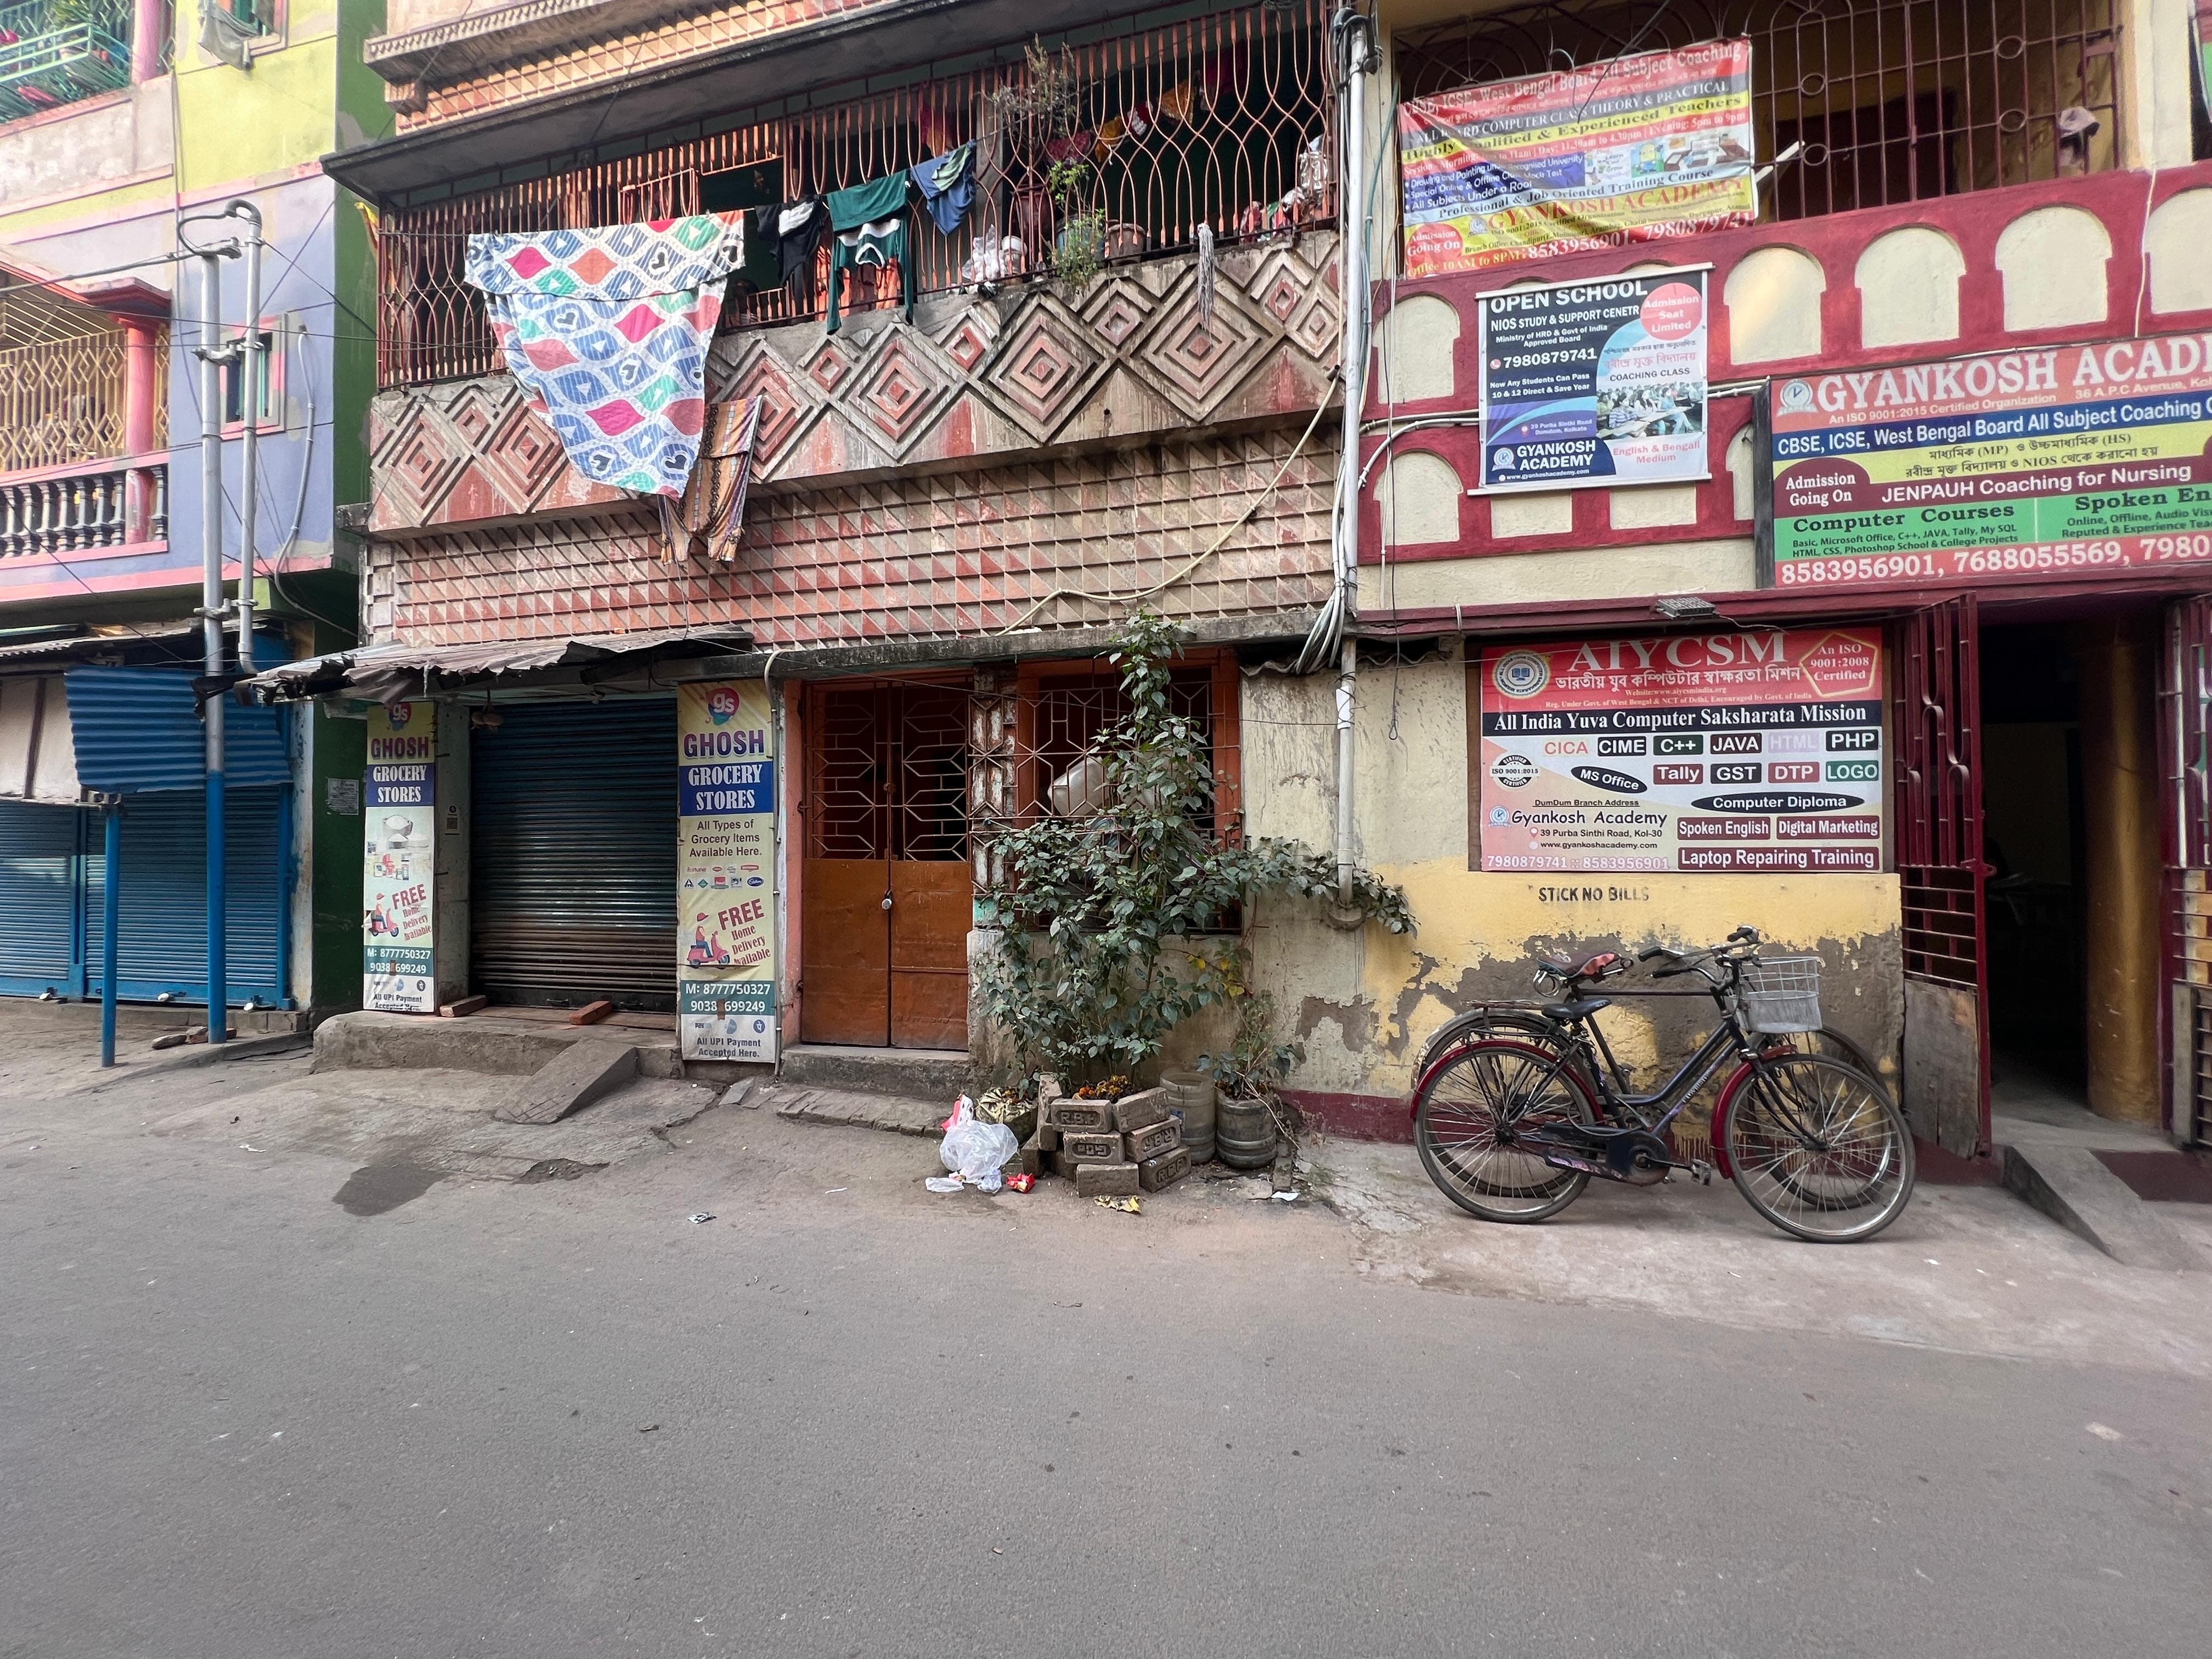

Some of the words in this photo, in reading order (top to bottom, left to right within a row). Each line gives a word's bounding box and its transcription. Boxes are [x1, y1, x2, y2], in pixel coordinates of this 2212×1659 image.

[1515, 73, 1555, 99] Bengal
[1677, 42, 1742, 66] Coaching
[1482, 110, 1547, 134] COMPUTER
[1593, 98, 1640, 115] THEORY
[1657, 81, 1729, 103] PRACTICAL
[1558, 110, 1660, 135] Experienced
[1669, 97, 1741, 114] Teachers
[1440, 199, 1509, 218] Professional
[1609, 177, 1664, 193] Training
[1668, 168, 1713, 182] Course
[1412, 230, 1456, 242] Admission
[1407, 242, 1441, 257] Going
[1443, 240, 1460, 250] On
[1443, 257, 1475, 270] 10AM
[1491, 292, 1549, 313] OPEN
[1555, 280, 1647, 306] SCHOOL
[1644, 296, 1699, 308] Admission
[1491, 318, 1517, 332] NIOS
[1519, 316, 1547, 329] STUDY
[1549, 315, 1556, 325] &
[1559, 309, 1601, 324] SUPPORT
[1604, 306, 1639, 318] CENETR
[1658, 309, 1684, 319] Seat
[1496, 335, 1525, 343] Ministry
[1562, 327, 1578, 335] Govt
[1652, 321, 1691, 332] Limited
[1503, 347, 1597, 369] 7980879741
[1610, 371, 1657, 382] COACHING
[1661, 368, 1690, 376] CLASS
[1817, 351, 2057, 413] GYANKOSH
[1829, 415, 1843, 424] An
[1846, 413, 1866, 422] ISO
[1929, 402, 1979, 414] Certified
[1778, 436, 1825, 455] CBSE,
[1829, 431, 1870, 449] ICSE,
[1874, 426, 1912, 446] West
[1916, 421, 1971, 443] Bengal
[1976, 415, 2023, 436] Board
[2028, 412, 2049, 431] All
[2053, 407, 2117, 430] Subject
[2120, 400, 2201, 422] Coaching
[1517, 440, 1596, 458] GYANKOSH
[1613, 446, 1648, 456] English
[1929, 446, 1974, 460] মাধ্যমিক
[2102, 433, 2132, 447] (HS)
[1520, 454, 1593, 471] ACADEMY
[1637, 455, 1676, 464] Medium
[2023, 457, 2057, 468] NIOS
[1785, 472, 1856, 490] Admission
[1882, 480, 1973, 503] JENPAUH
[1979, 475, 2072, 495] Coaching
[2077, 471, 2106, 487] for
[2111, 465, 2192, 484] Nursing
[1790, 490, 1829, 507] Going
[1832, 489, 1852, 503] On
[2075, 493, 2168, 514] Spoken
[1793, 513, 1905, 533] Computer
[1921, 505, 2015, 523] Courses
[2155, 510, 2189, 520] Audio
[1820, 535, 1864, 546] Microsoft
[1866, 533, 1895, 542] Office,
[1980, 526, 1995, 535] My
[1998, 524, 2017, 533] SQL
[2062, 527, 2109, 538] Reputed
[2124, 522, 2186, 535] Experience
[1844, 542, 1895, 554] Photoshop
[1898, 540, 1928, 550] School
[1940, 537, 1976, 548] College
[1979, 534, 2018, 546] Projects
[1781, 555, 1944, 584] 8583956901,
[1953, 540, 2130, 572] 7688055569,
[1566, 631, 1788, 672] AIYCSM
[1818, 646, 1835, 655] An
[1839, 644, 1862, 653] ISO
[1810, 657, 1869, 668] 9001:2008
[1555, 672, 1606, 690] ভারতীয়
[1610, 674, 1628, 693] যুব
[1630, 669, 1700, 687] কম্পিউটার
[1703, 667, 1762, 684] স্বাক্ষরতা
[1765, 663, 1802, 681] মিশন
[1814, 670, 1865, 681] Certified
[1494, 713, 1516, 731] All
[1521, 713, 1562, 730] India
[1567, 713, 1608, 729] Yuva
[1612, 710, 1696, 731] Computer
[1700, 707, 1795, 726] Saksharata
[1801, 704, 1866, 722] Mission
[371, 736, 429, 760] GHOSH
[684, 730, 764, 758] GHOSH
[1545, 741, 1588, 755] CICA
[1599, 740, 1645, 753] CIME
[1660, 739, 1696, 753] C++
[1713, 736, 1759, 752] JAVA
[1831, 733, 1875, 749] PHP
[373, 765, 427, 782] GROCERY
[688, 764, 763, 786] GROCERY
[1580, 769, 1599, 781] MS
[1601, 774, 1639, 791] Office
[1657, 766, 1700, 783] Tally
[1717, 766, 1757, 781] GST
[1775, 766, 1813, 780] DTP
[1827, 764, 1877, 780] LOGO
[377, 786, 421, 803] STORES
[696, 789, 755, 810] STORES
[1713, 797, 1784, 811] Computer
[1787, 796, 1847, 809] Diploma
[697, 820, 709, 830] All
[713, 820, 741, 831] Types
[744, 819, 754, 828] of
[1512, 810, 1585, 827] Gyankosh
[1594, 810, 1667, 828] Academy
[1553, 829, 1578, 837] Purba
[1581, 829, 1604, 837] Sinthi
[1607, 830, 1632, 838] Road,
[1679, 821, 1722, 837] Spoken
[1725, 821, 1769, 837] English
[1779, 820, 1815, 836] Digital
[1818, 820, 1878, 837] Marketing
[691, 834, 730, 845] Grocery
[733, 833, 760, 843] Items
[1541, 842, 1657, 850] www.gyankoshacademy.com
[690, 847, 733, 857] Available
[736, 847, 762, 856] Here.
[1681, 850, 1731, 868] Laptop
[1736, 850, 1807, 869] Repairing
[1812, 849, 1874, 868] Training
[1487, 855, 1567, 868] 7980879741
[1582, 856, 1669, 870] 8583956901
[392, 884, 427, 910] FREE
[1538, 887, 1578, 901] STICK
[1582, 887, 1602, 901] NO
[1609, 886, 1649, 901] BILLS
[403, 915, 428, 929] Delivery
[718, 898, 764, 930] FREE
[731, 925, 756, 941] Home
[380, 948, 431, 959] 8777750327
[732, 935, 765, 955] Delivery
[686, 983, 699, 994] M:
[703, 984, 770, 995] 8777750327
[396, 994, 422, 1003] Payment
[727, 1038, 761, 1047] Payment
[698, 1048, 736, 1057] Accepted
